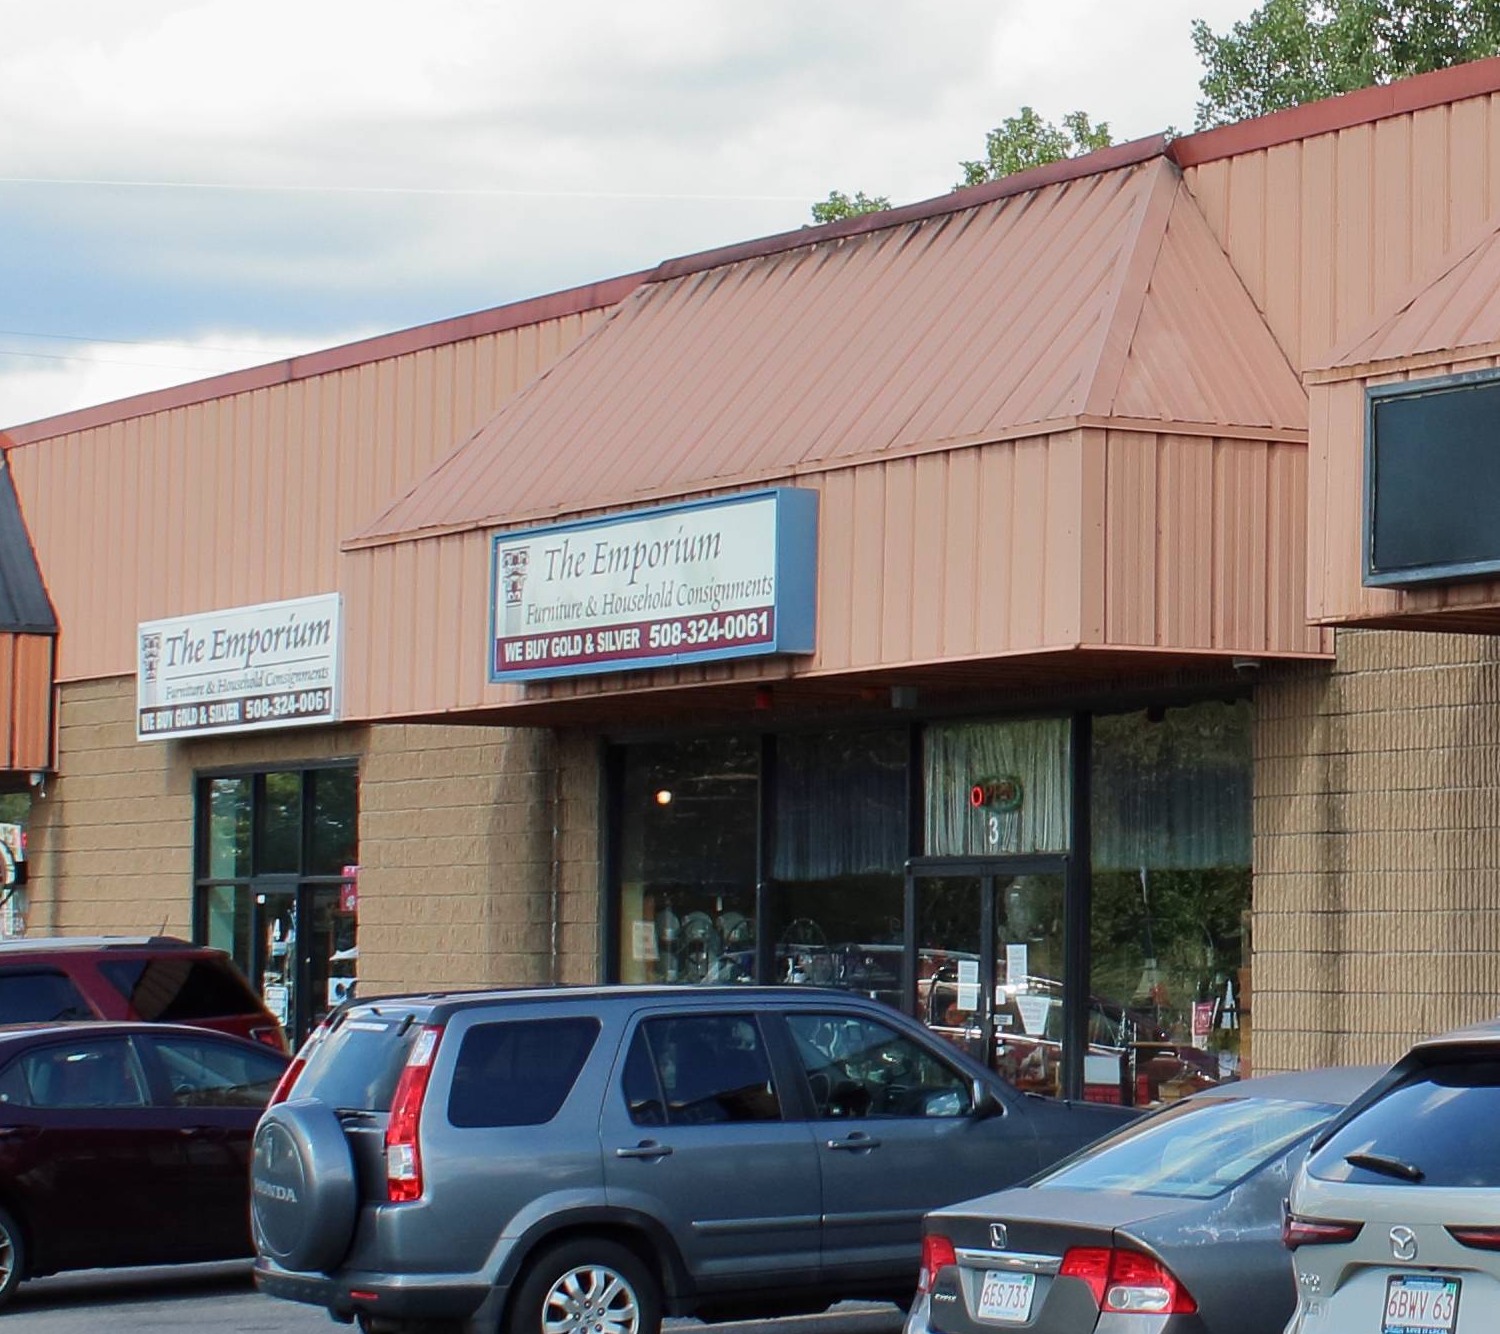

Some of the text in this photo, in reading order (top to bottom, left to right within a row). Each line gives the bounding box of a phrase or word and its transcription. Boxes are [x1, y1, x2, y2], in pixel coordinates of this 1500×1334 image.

[545, 525, 721, 586] The Emporium
[525, 574, 773, 625] Furniture & Household Consignments
[166, 613, 331, 670] The Emporium
[504, 611, 768, 663] WE BUY GOLD & SILVER 508-324-0061
[165, 667, 329, 700] Furniture & Household Consignments
[141, 690, 330, 732] WE BUY GOLD & SILVER 508-324-0061
[989, 816, 999, 844] 3
[254, 1178, 298, 1203] HONDA
[982, 1283, 1029, 1308] 6ES 733
[1388, 1290, 1454, 1320] 6BWV 63
